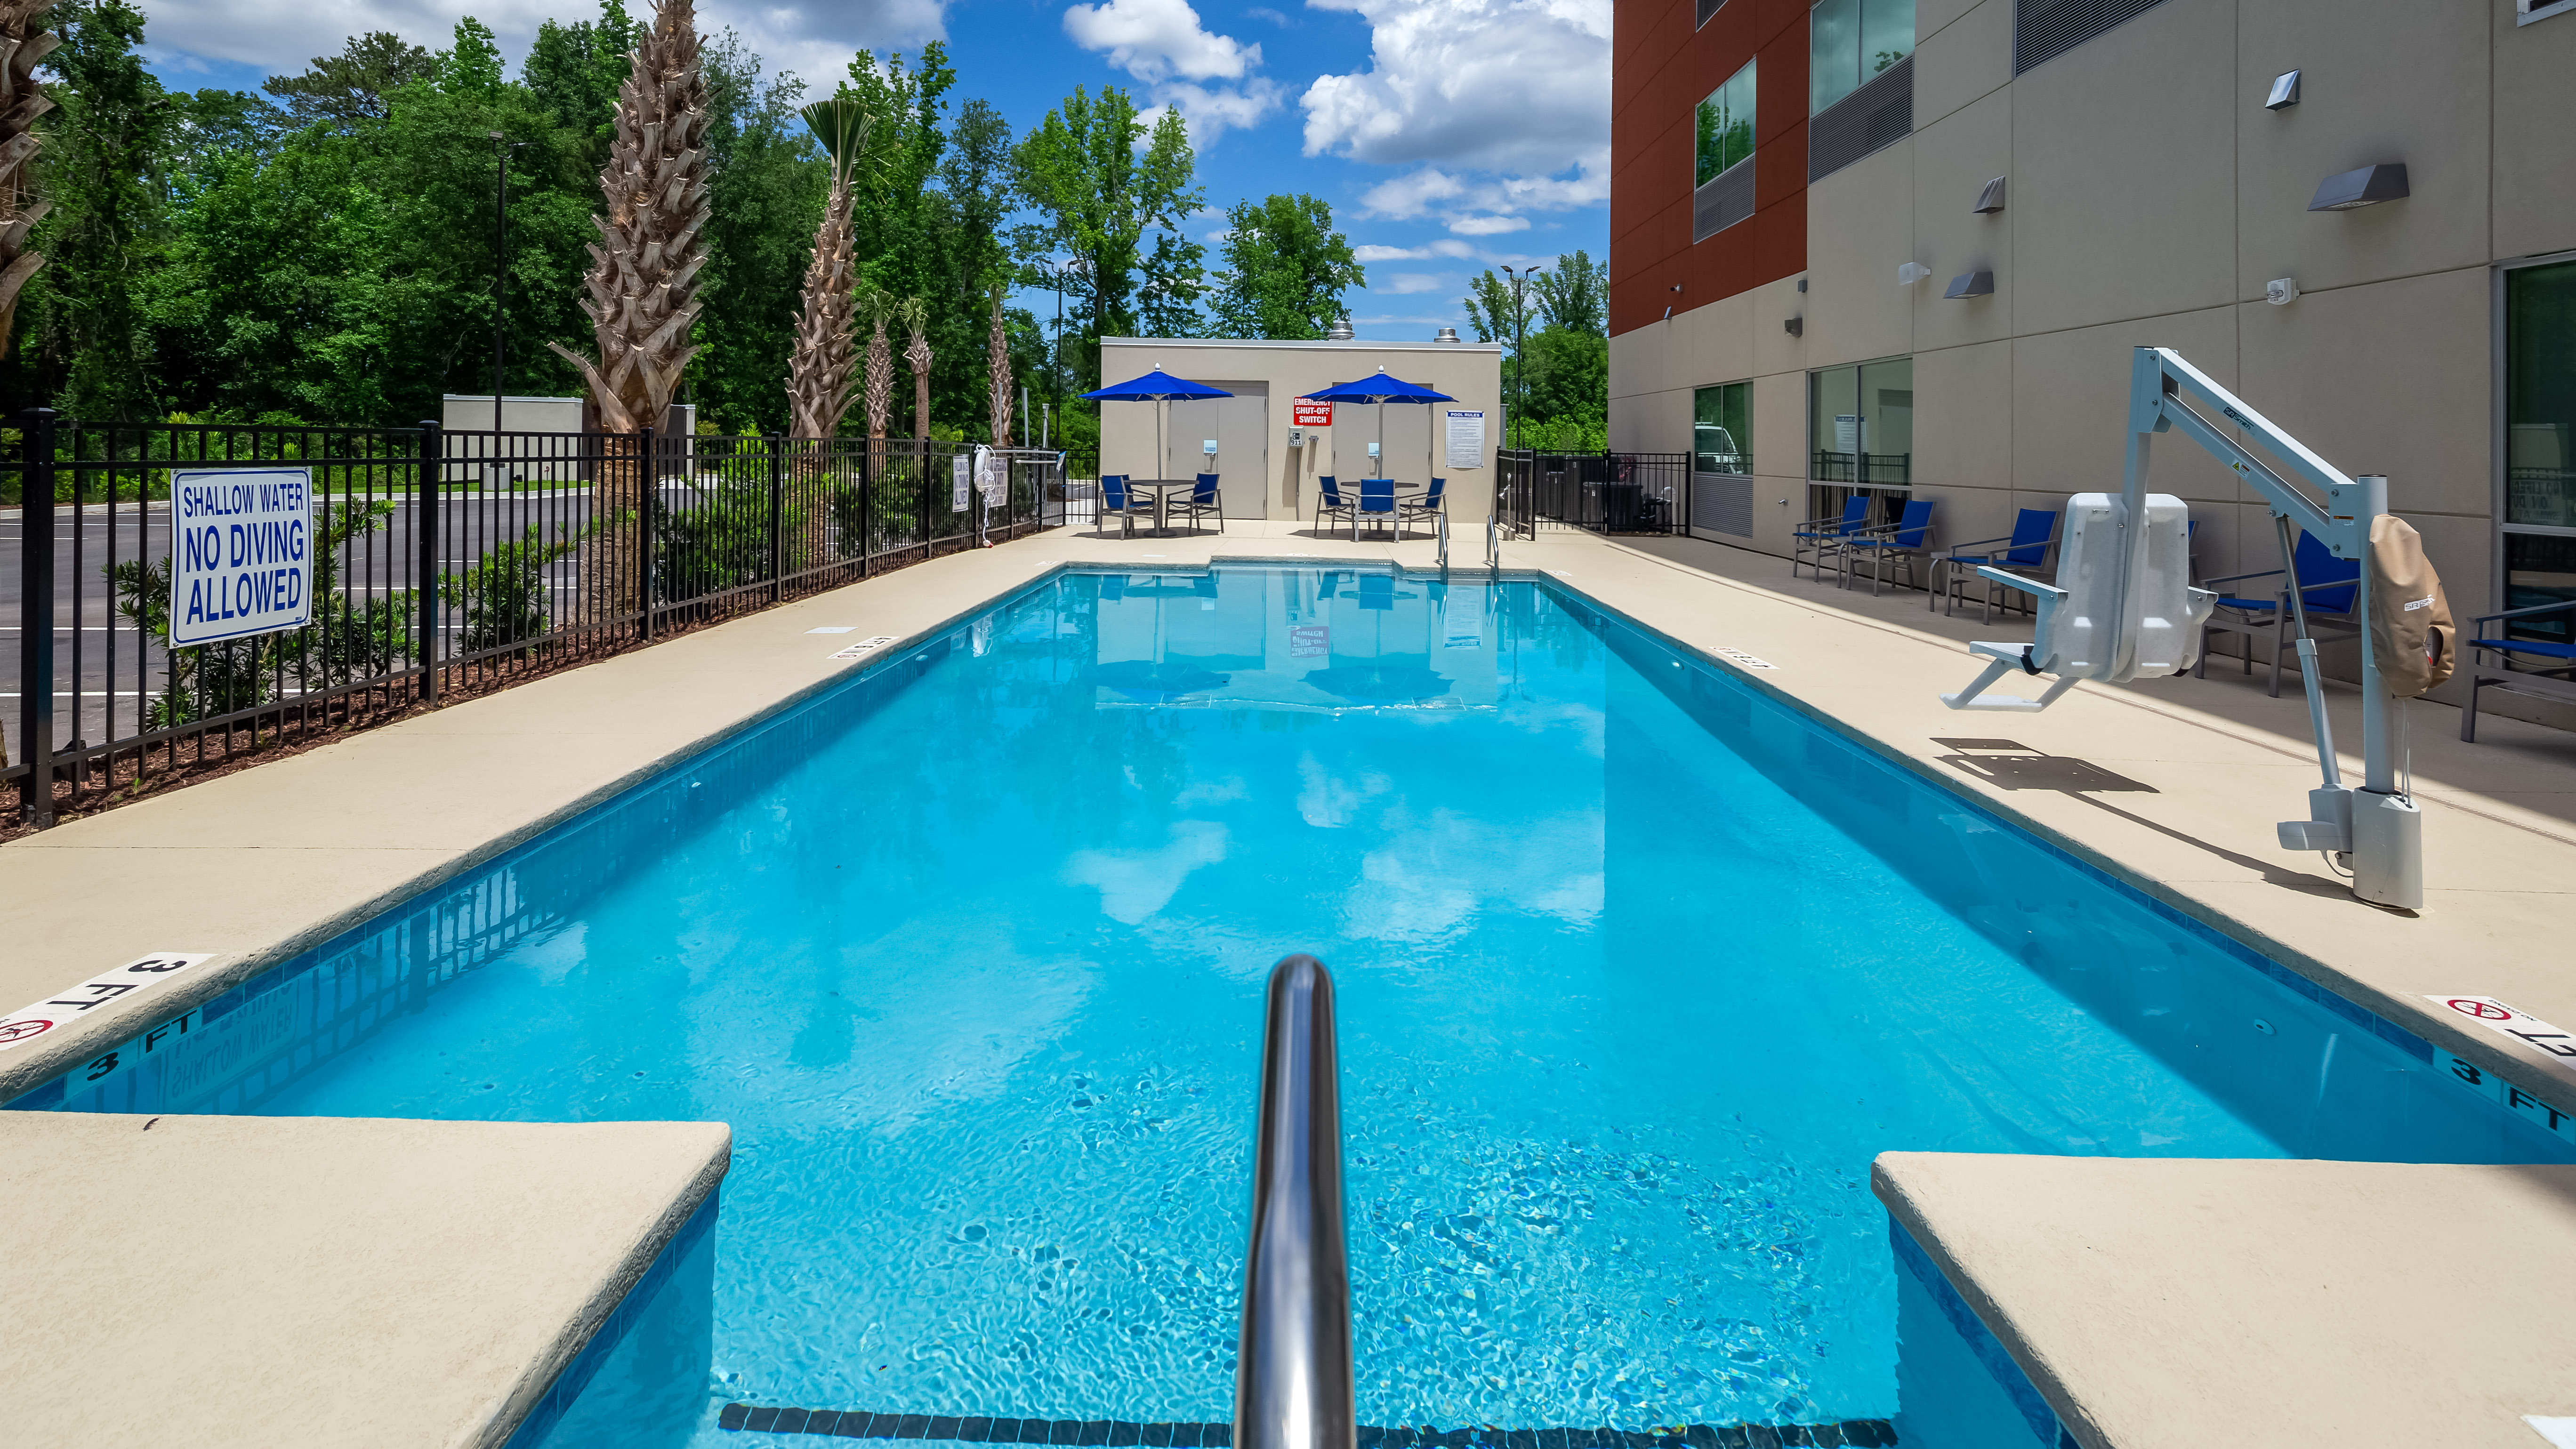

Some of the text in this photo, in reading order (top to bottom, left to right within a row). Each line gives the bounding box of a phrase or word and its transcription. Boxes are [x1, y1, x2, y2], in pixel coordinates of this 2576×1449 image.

[2234, 414, 2251, 430] Smith
[184, 483, 303, 518] SHALLOW WATER
[186, 519, 303, 572] NO DIVING
[186, 567, 301, 625] ALLOWED
[46, 959, 187, 1011] 3 FT
[87, 1052, 119, 1081] 3
[145, 1010, 198, 1054] FT
[2451, 1058, 2570, 1131] 3 FT
